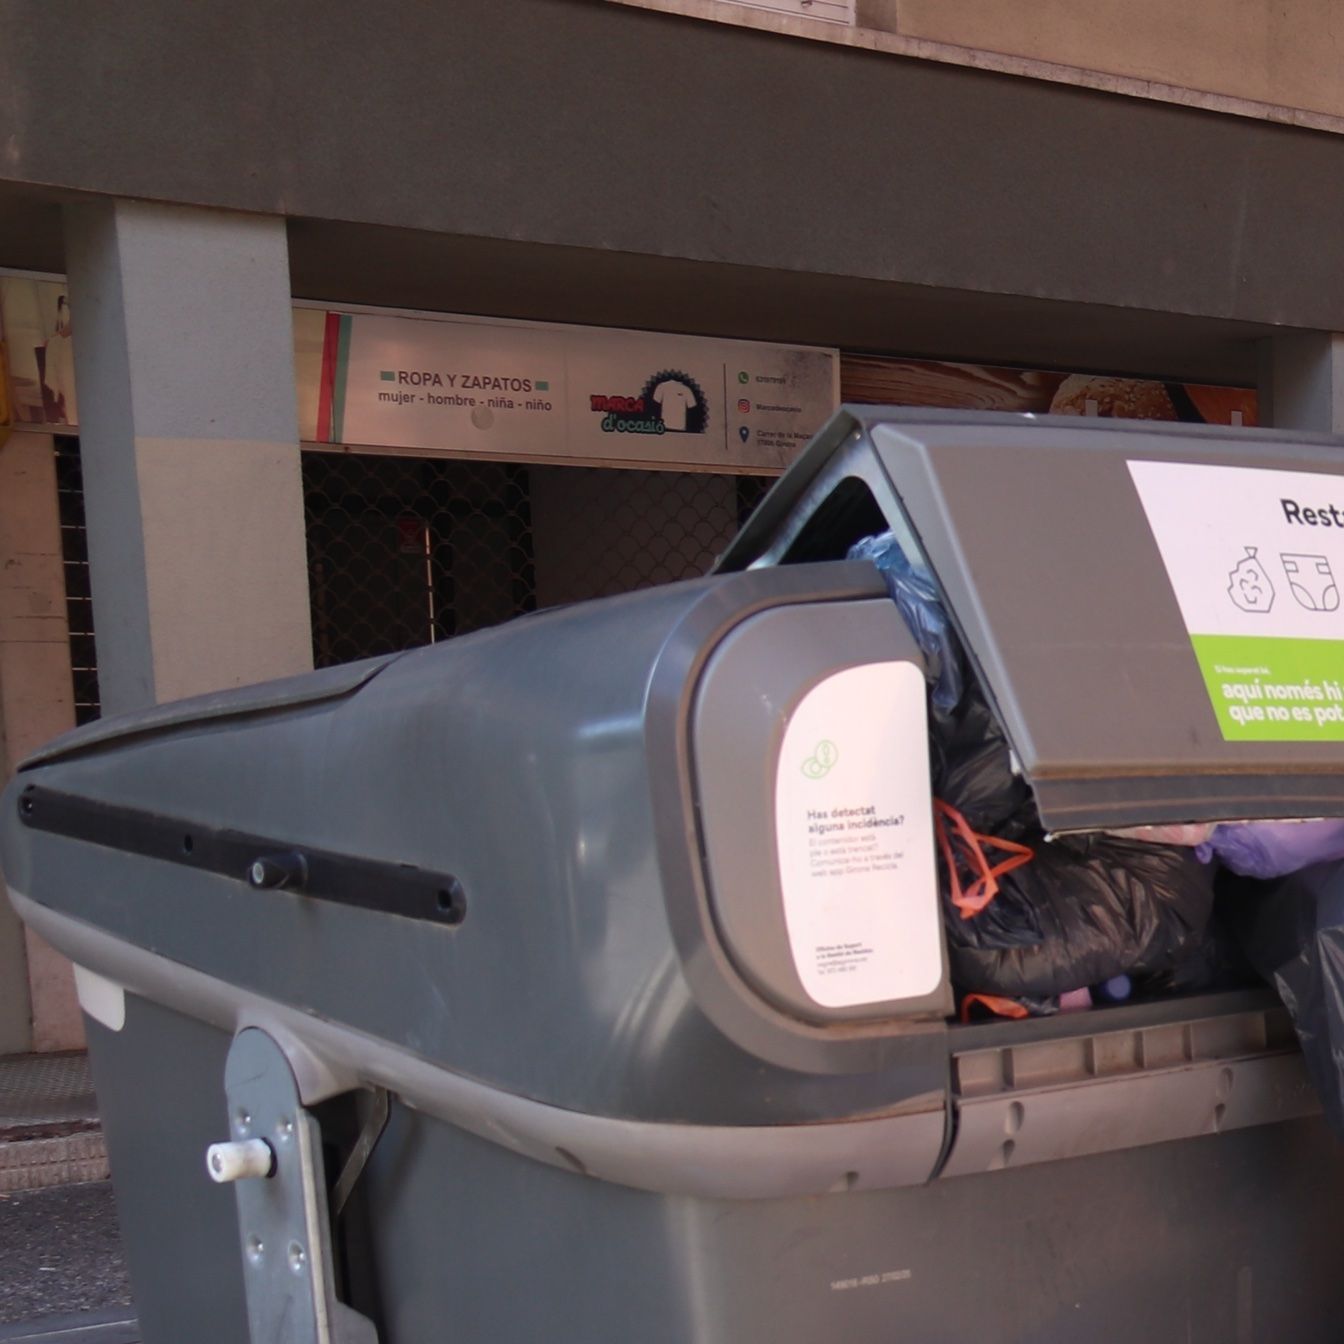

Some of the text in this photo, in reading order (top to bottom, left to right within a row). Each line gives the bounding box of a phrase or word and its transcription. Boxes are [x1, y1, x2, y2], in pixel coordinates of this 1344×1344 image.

[398, 370, 533, 393] ROPA Y ZAPATOS
[378, 391, 416, 405] mujer
[427, 393, 476, 407] hombre
[487, 397, 514, 409] niña
[525, 399, 552, 412] niño
[590, 395, 645, 412] MARCA
[601, 414, 665, 434] d'ocasió
[1222, 678, 1262, 703] aquí
[1265, 679, 1322, 700] només
[1324, 680, 1342, 700] hi
[1229, 705, 1263, 726] que
[1265, 707, 1290, 721] no
[1292, 709, 1312, 722] es
[807, 806, 876, 820] Has detectat
[808, 815, 905, 834] alguna incidència?
